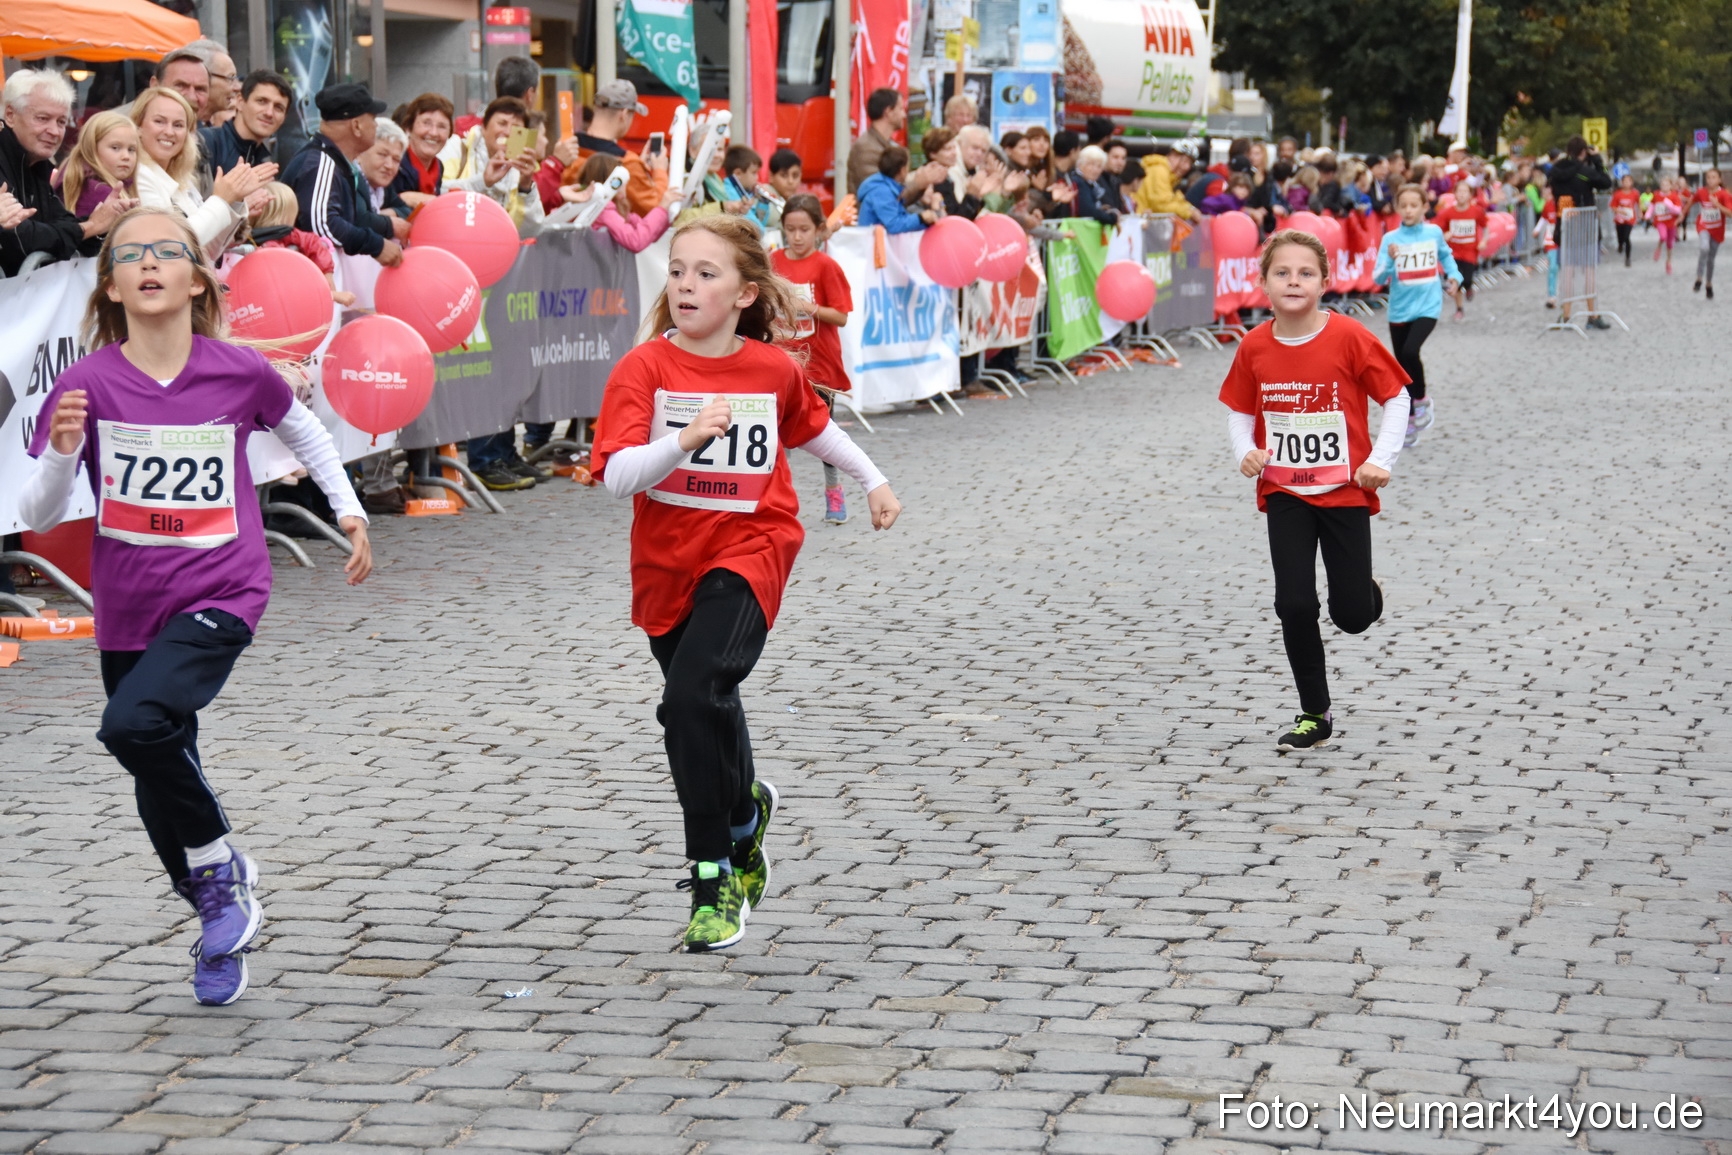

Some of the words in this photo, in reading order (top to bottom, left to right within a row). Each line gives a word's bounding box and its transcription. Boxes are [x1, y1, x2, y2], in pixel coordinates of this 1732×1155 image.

[644, 23, 692, 53] ice-
[1141, 4, 1195, 57] AVIA
[1138, 61, 1194, 105] Pellets
[1400, 251, 1435, 268] 7175
[227, 303, 263, 323] ÖDL
[1261, 381, 1312, 391] Neumarkter
[716, 398, 768, 412] OCK
[1295, 415, 1339, 427] BOCK
[111, 434, 152, 447] NeuerMarkt
[161, 430, 226, 445] BOCK
[1273, 432, 1340, 463] 7093
[114, 452, 224, 501] 7223
[686, 476, 738, 495] Emma
[1291, 472, 1315, 484] Jule
[150, 514, 183, 532] Ella
